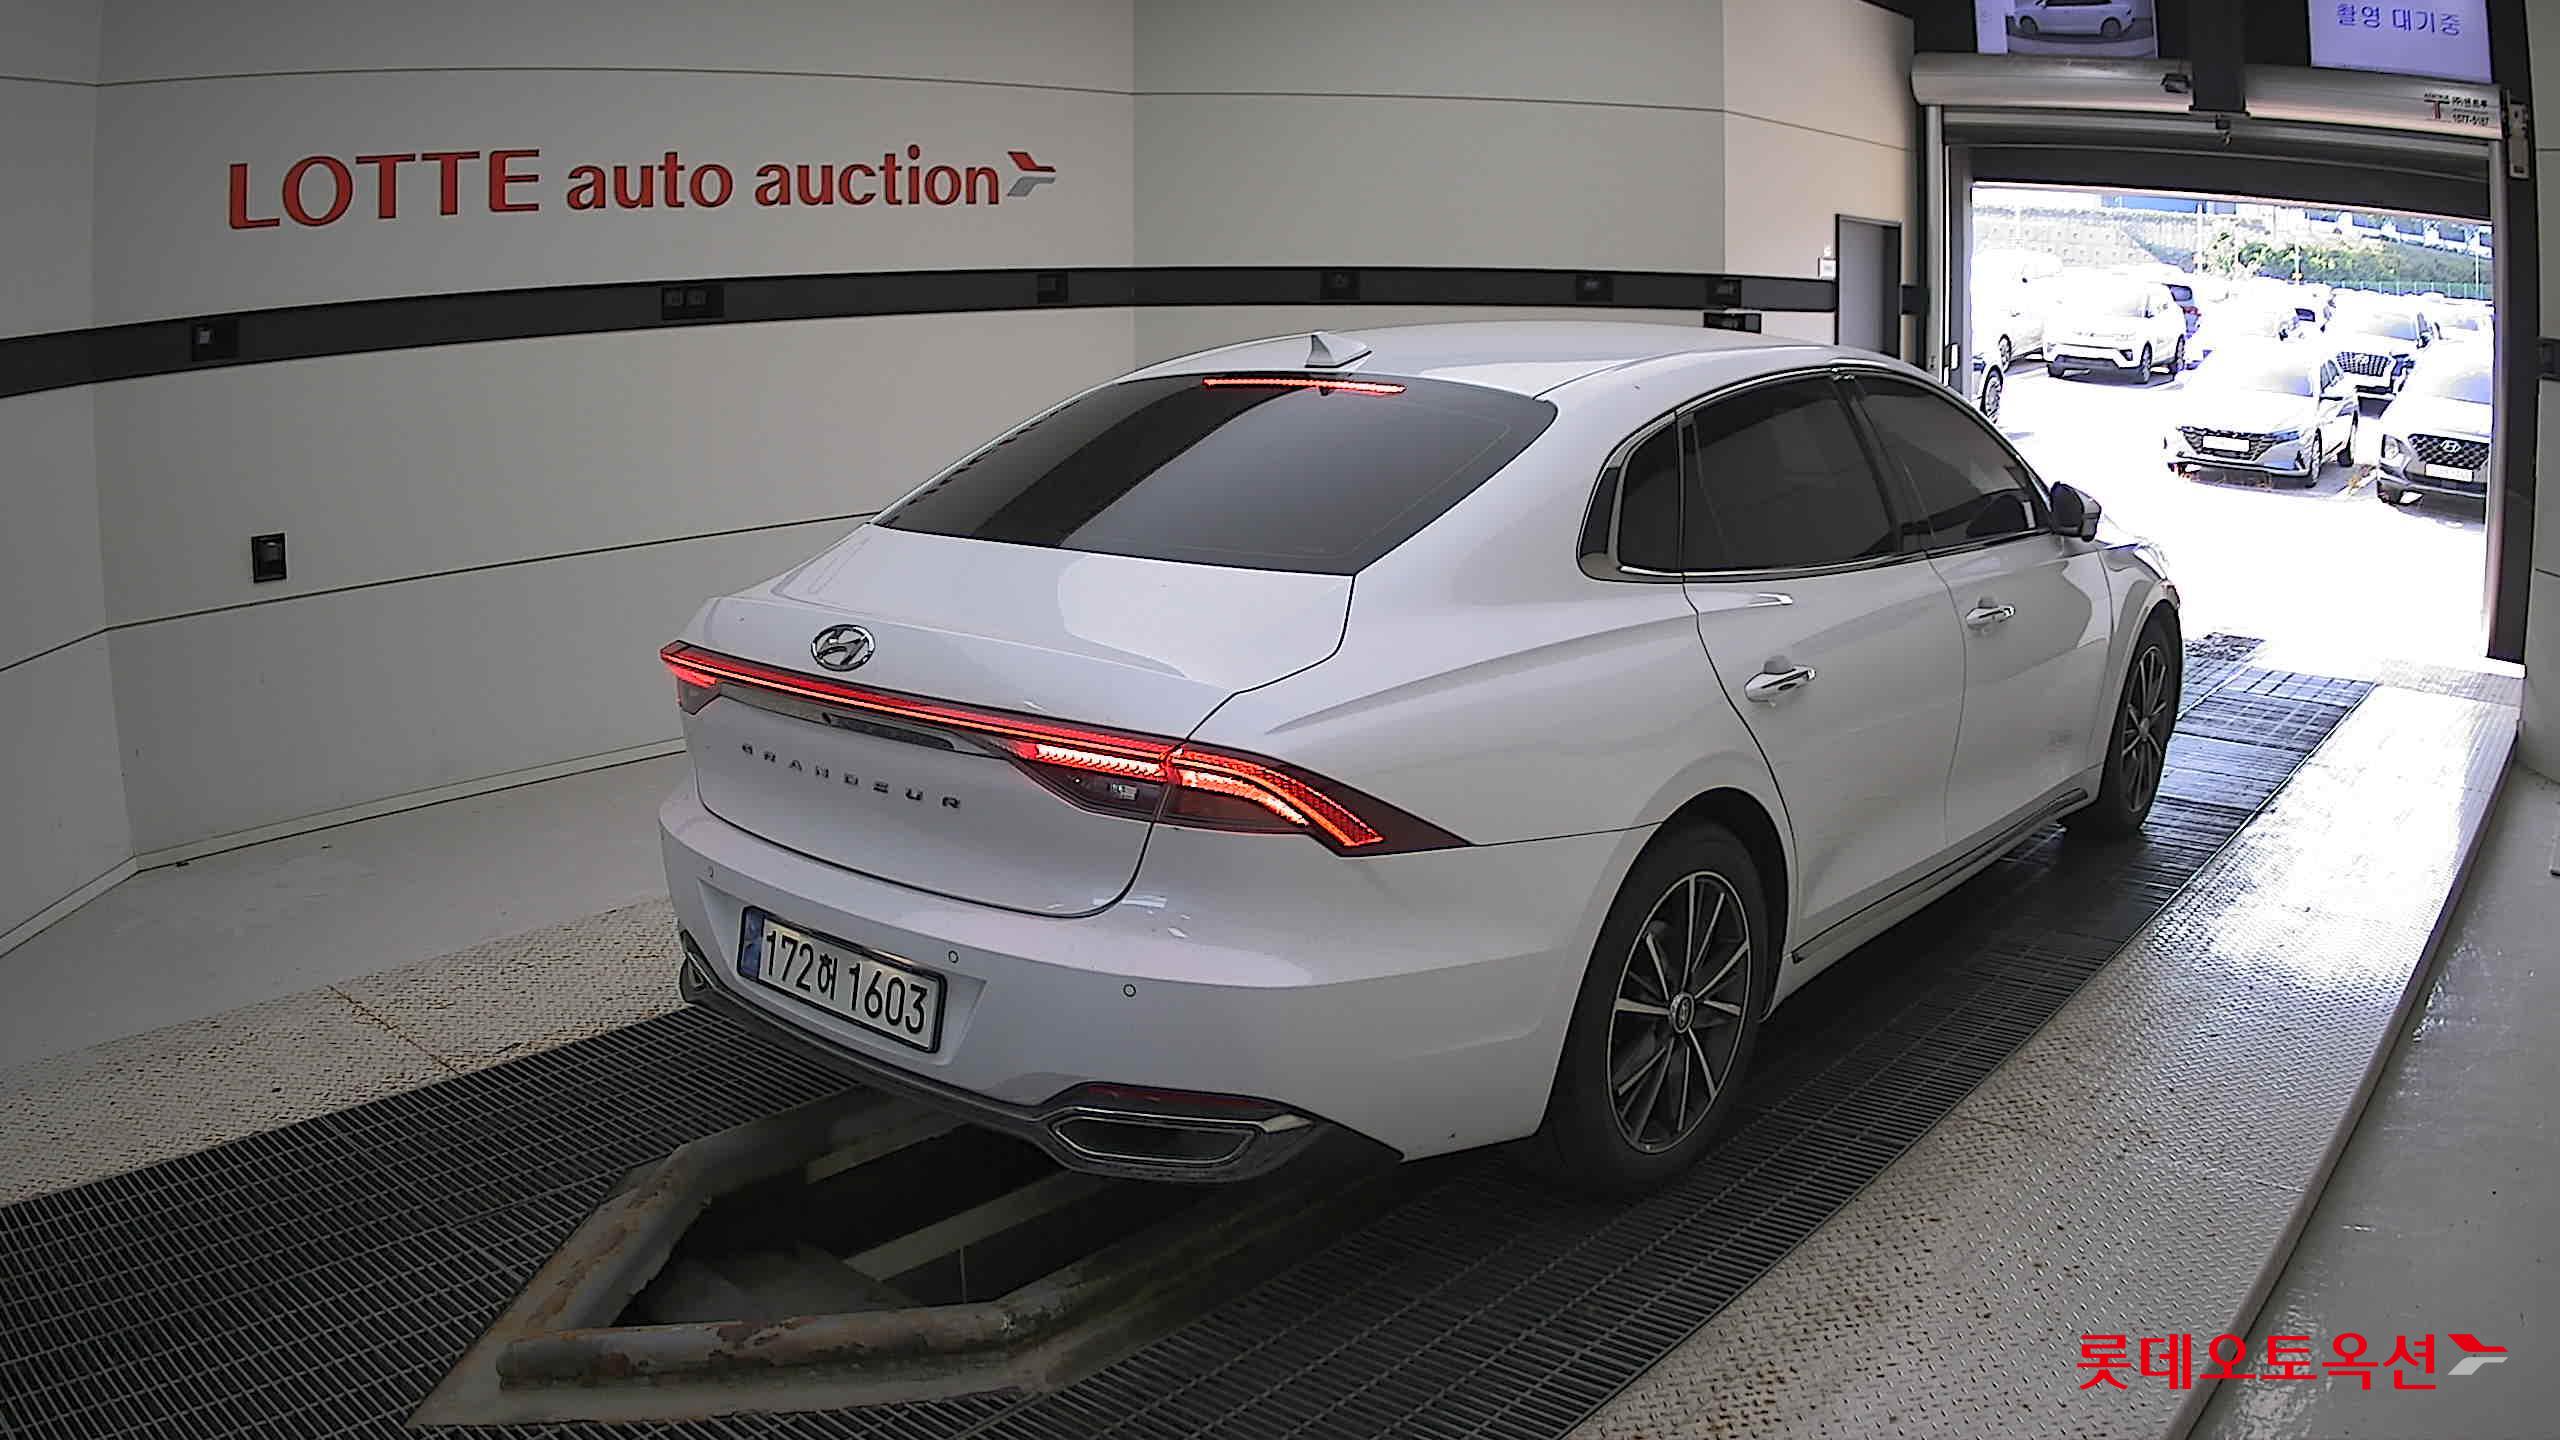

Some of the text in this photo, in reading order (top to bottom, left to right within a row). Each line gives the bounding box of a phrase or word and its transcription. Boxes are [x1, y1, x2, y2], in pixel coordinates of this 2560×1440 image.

[2337, 3, 2460, 36] 촬영 대기중
[229, 145, 1001, 230] LOTTE auto auction
[849, 962, 928, 1035] 1603
